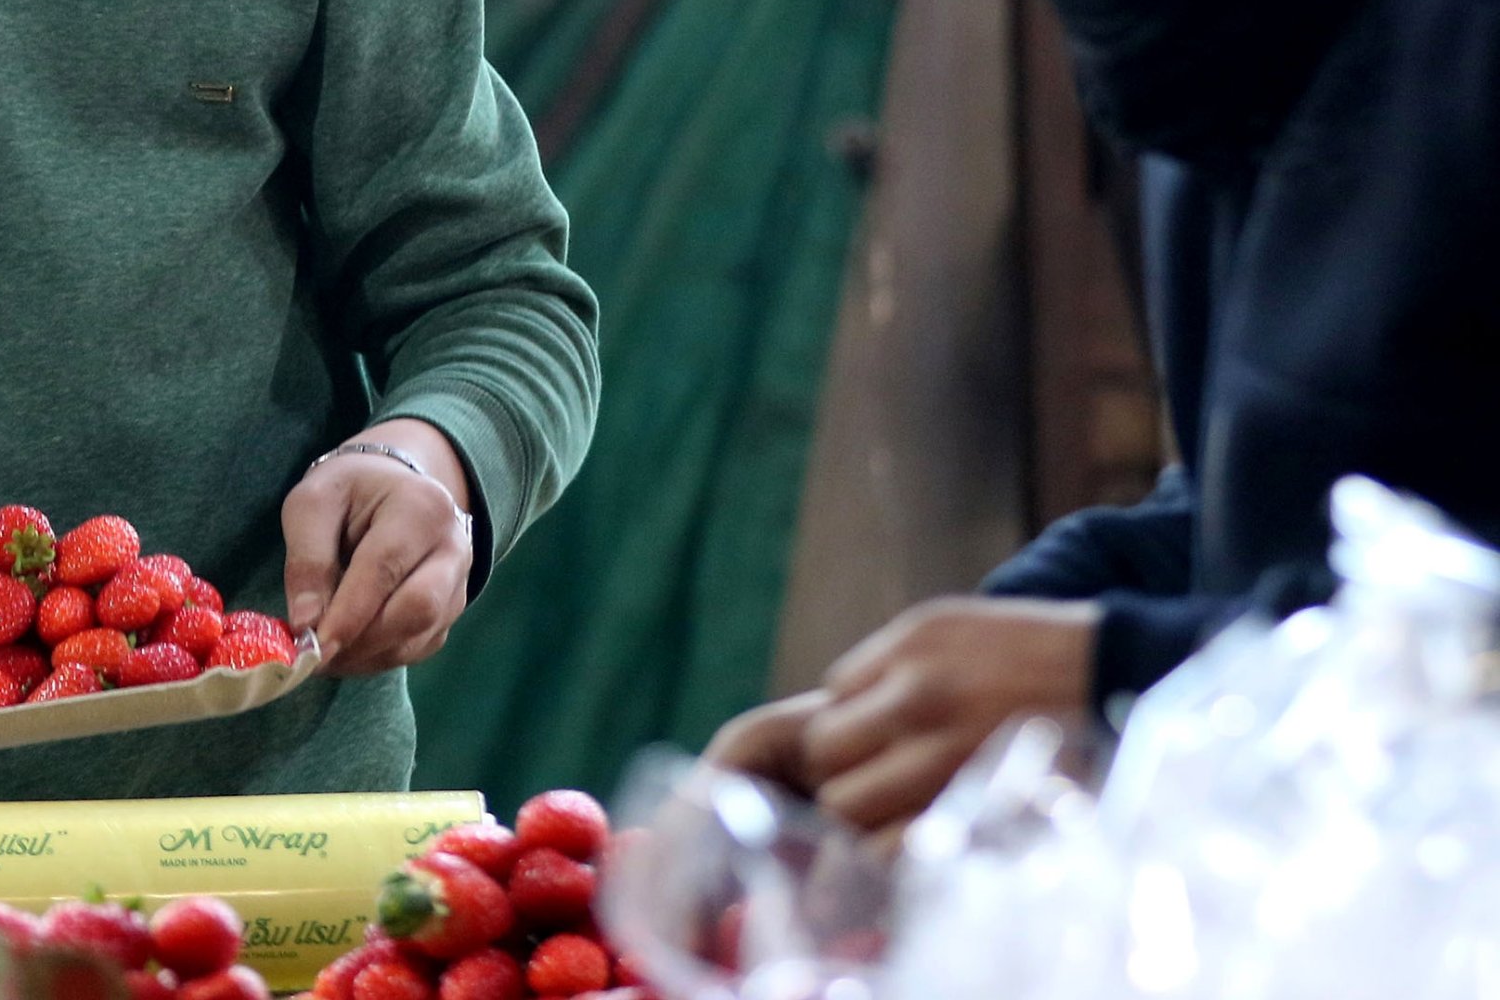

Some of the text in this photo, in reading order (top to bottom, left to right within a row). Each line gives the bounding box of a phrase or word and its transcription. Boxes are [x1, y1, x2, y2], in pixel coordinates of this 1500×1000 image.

[158, 824, 329, 856] M Wrap
[159, 857, 248, 868] MADE IN THAILAND
